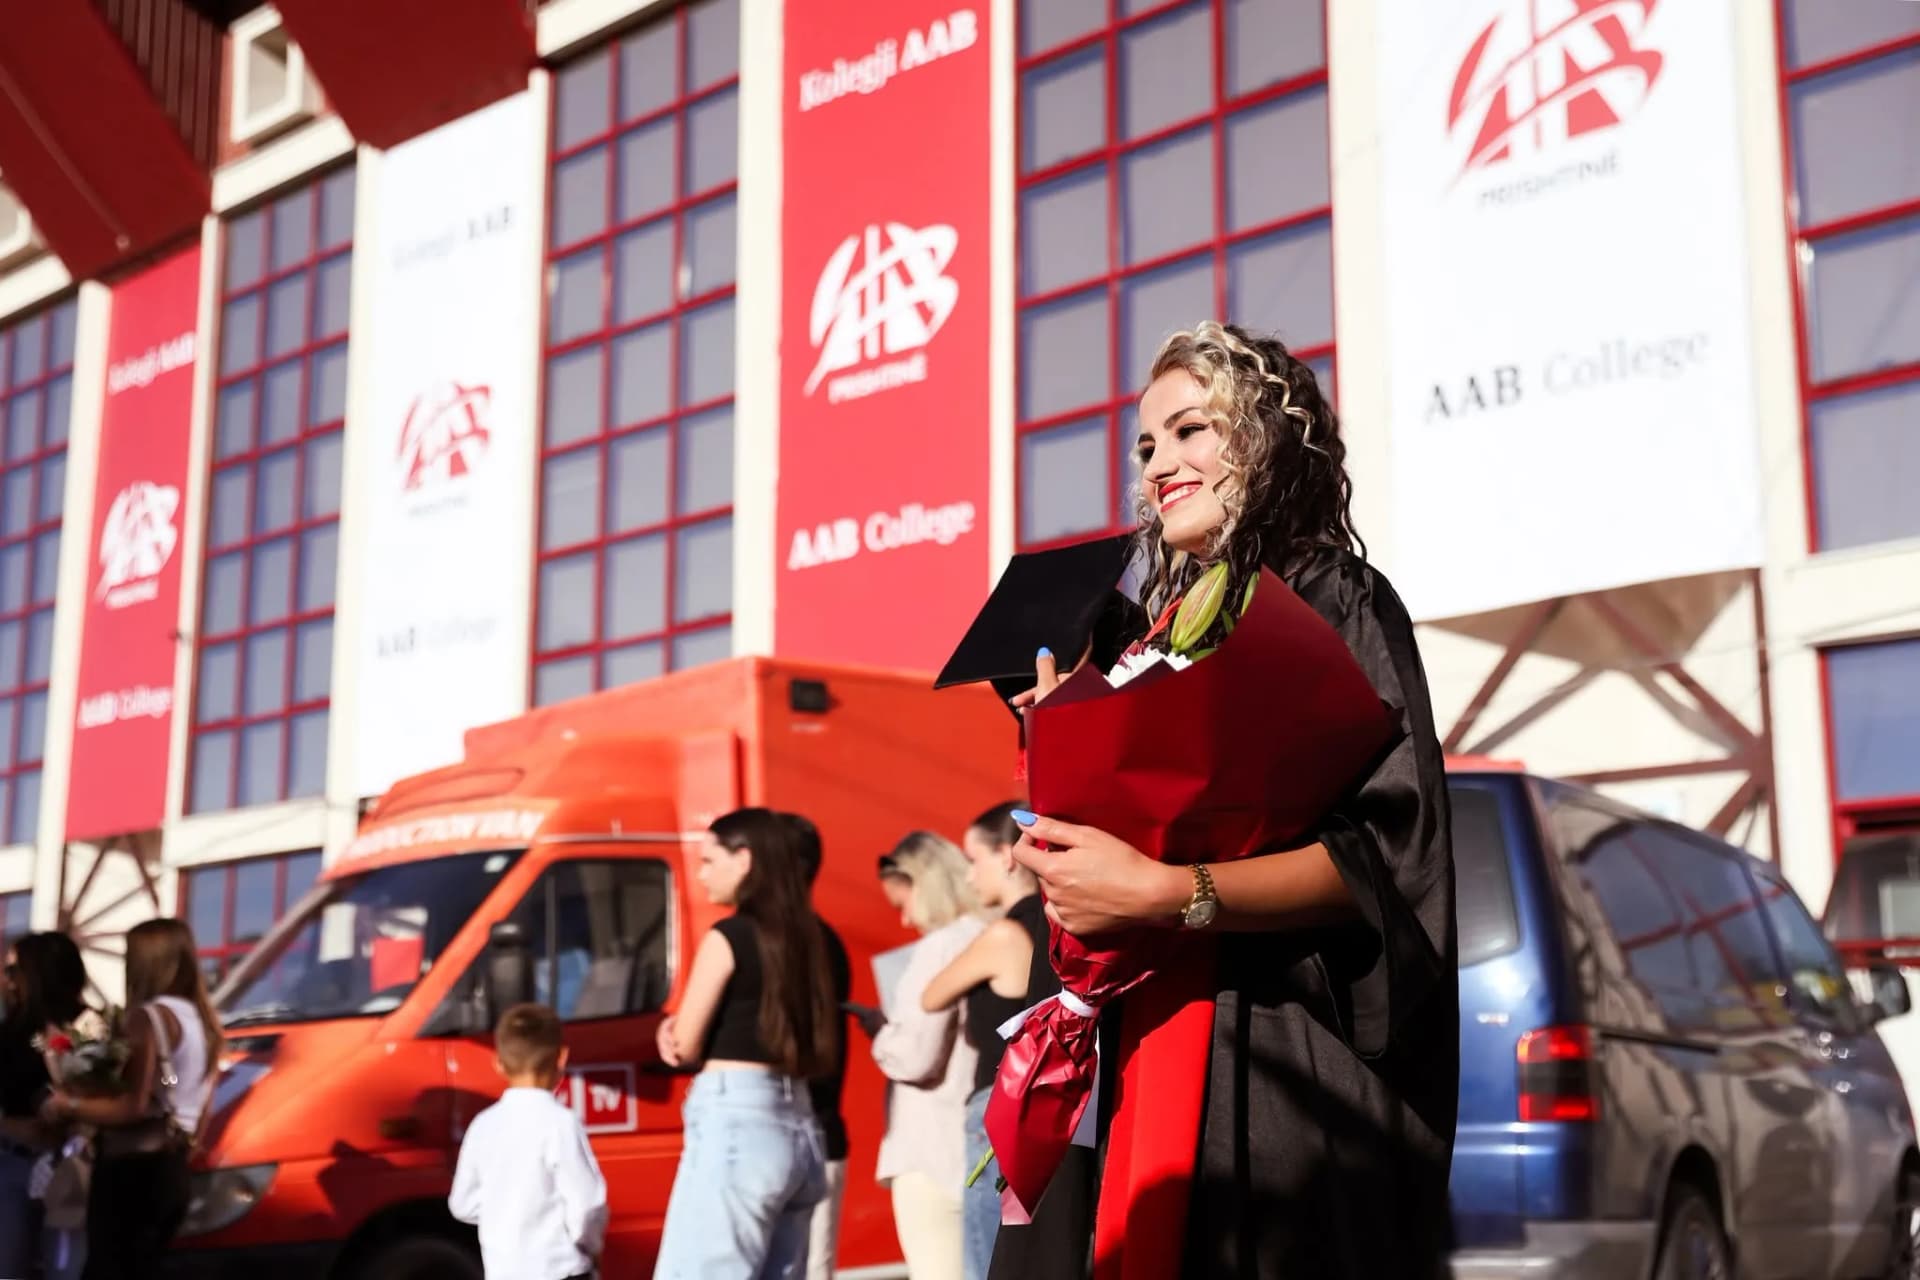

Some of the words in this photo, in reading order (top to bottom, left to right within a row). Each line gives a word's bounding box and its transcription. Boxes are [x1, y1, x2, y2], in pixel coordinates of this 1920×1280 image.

[800, 38, 898, 112] Kolegji
[900, 8, 978, 71] AAB
[1424, 364, 1523, 425] AAB
[1541, 332, 1711, 396] College
[787, 518, 860, 571] AAB
[864, 501, 975, 553] College
